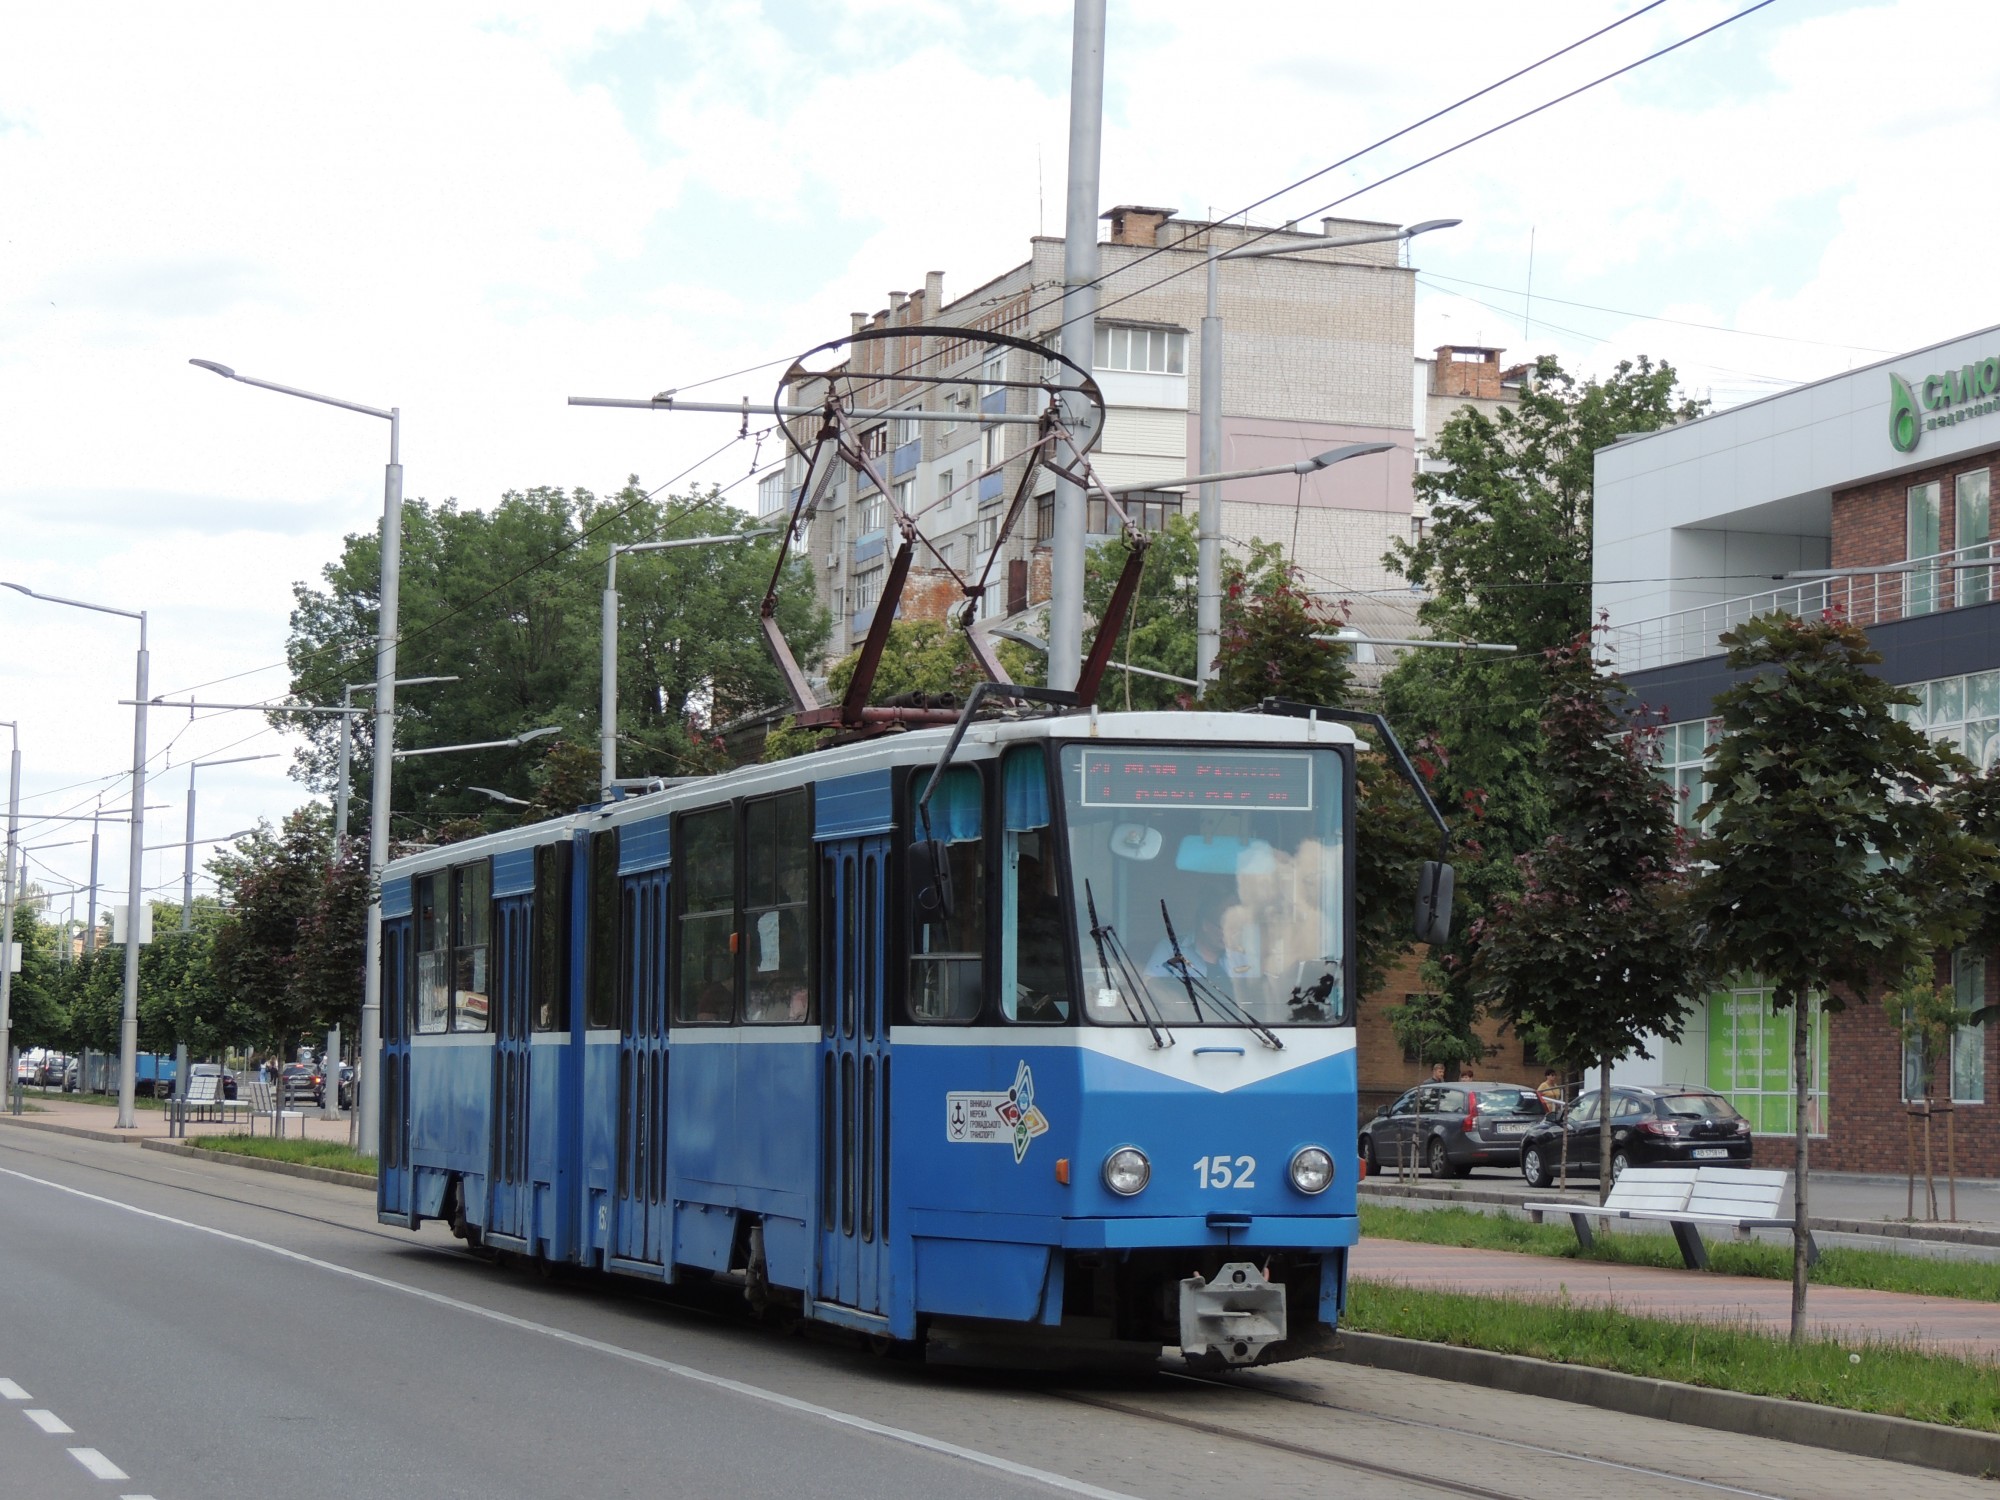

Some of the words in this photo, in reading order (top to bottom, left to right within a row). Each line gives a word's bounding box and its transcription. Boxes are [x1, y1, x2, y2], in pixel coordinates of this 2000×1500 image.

[1922, 356, 2000, 410] САЛЮ
[969, 1110, 987, 1118] МЕРЕЖА
[1193, 1155, 1256, 1189] 152
